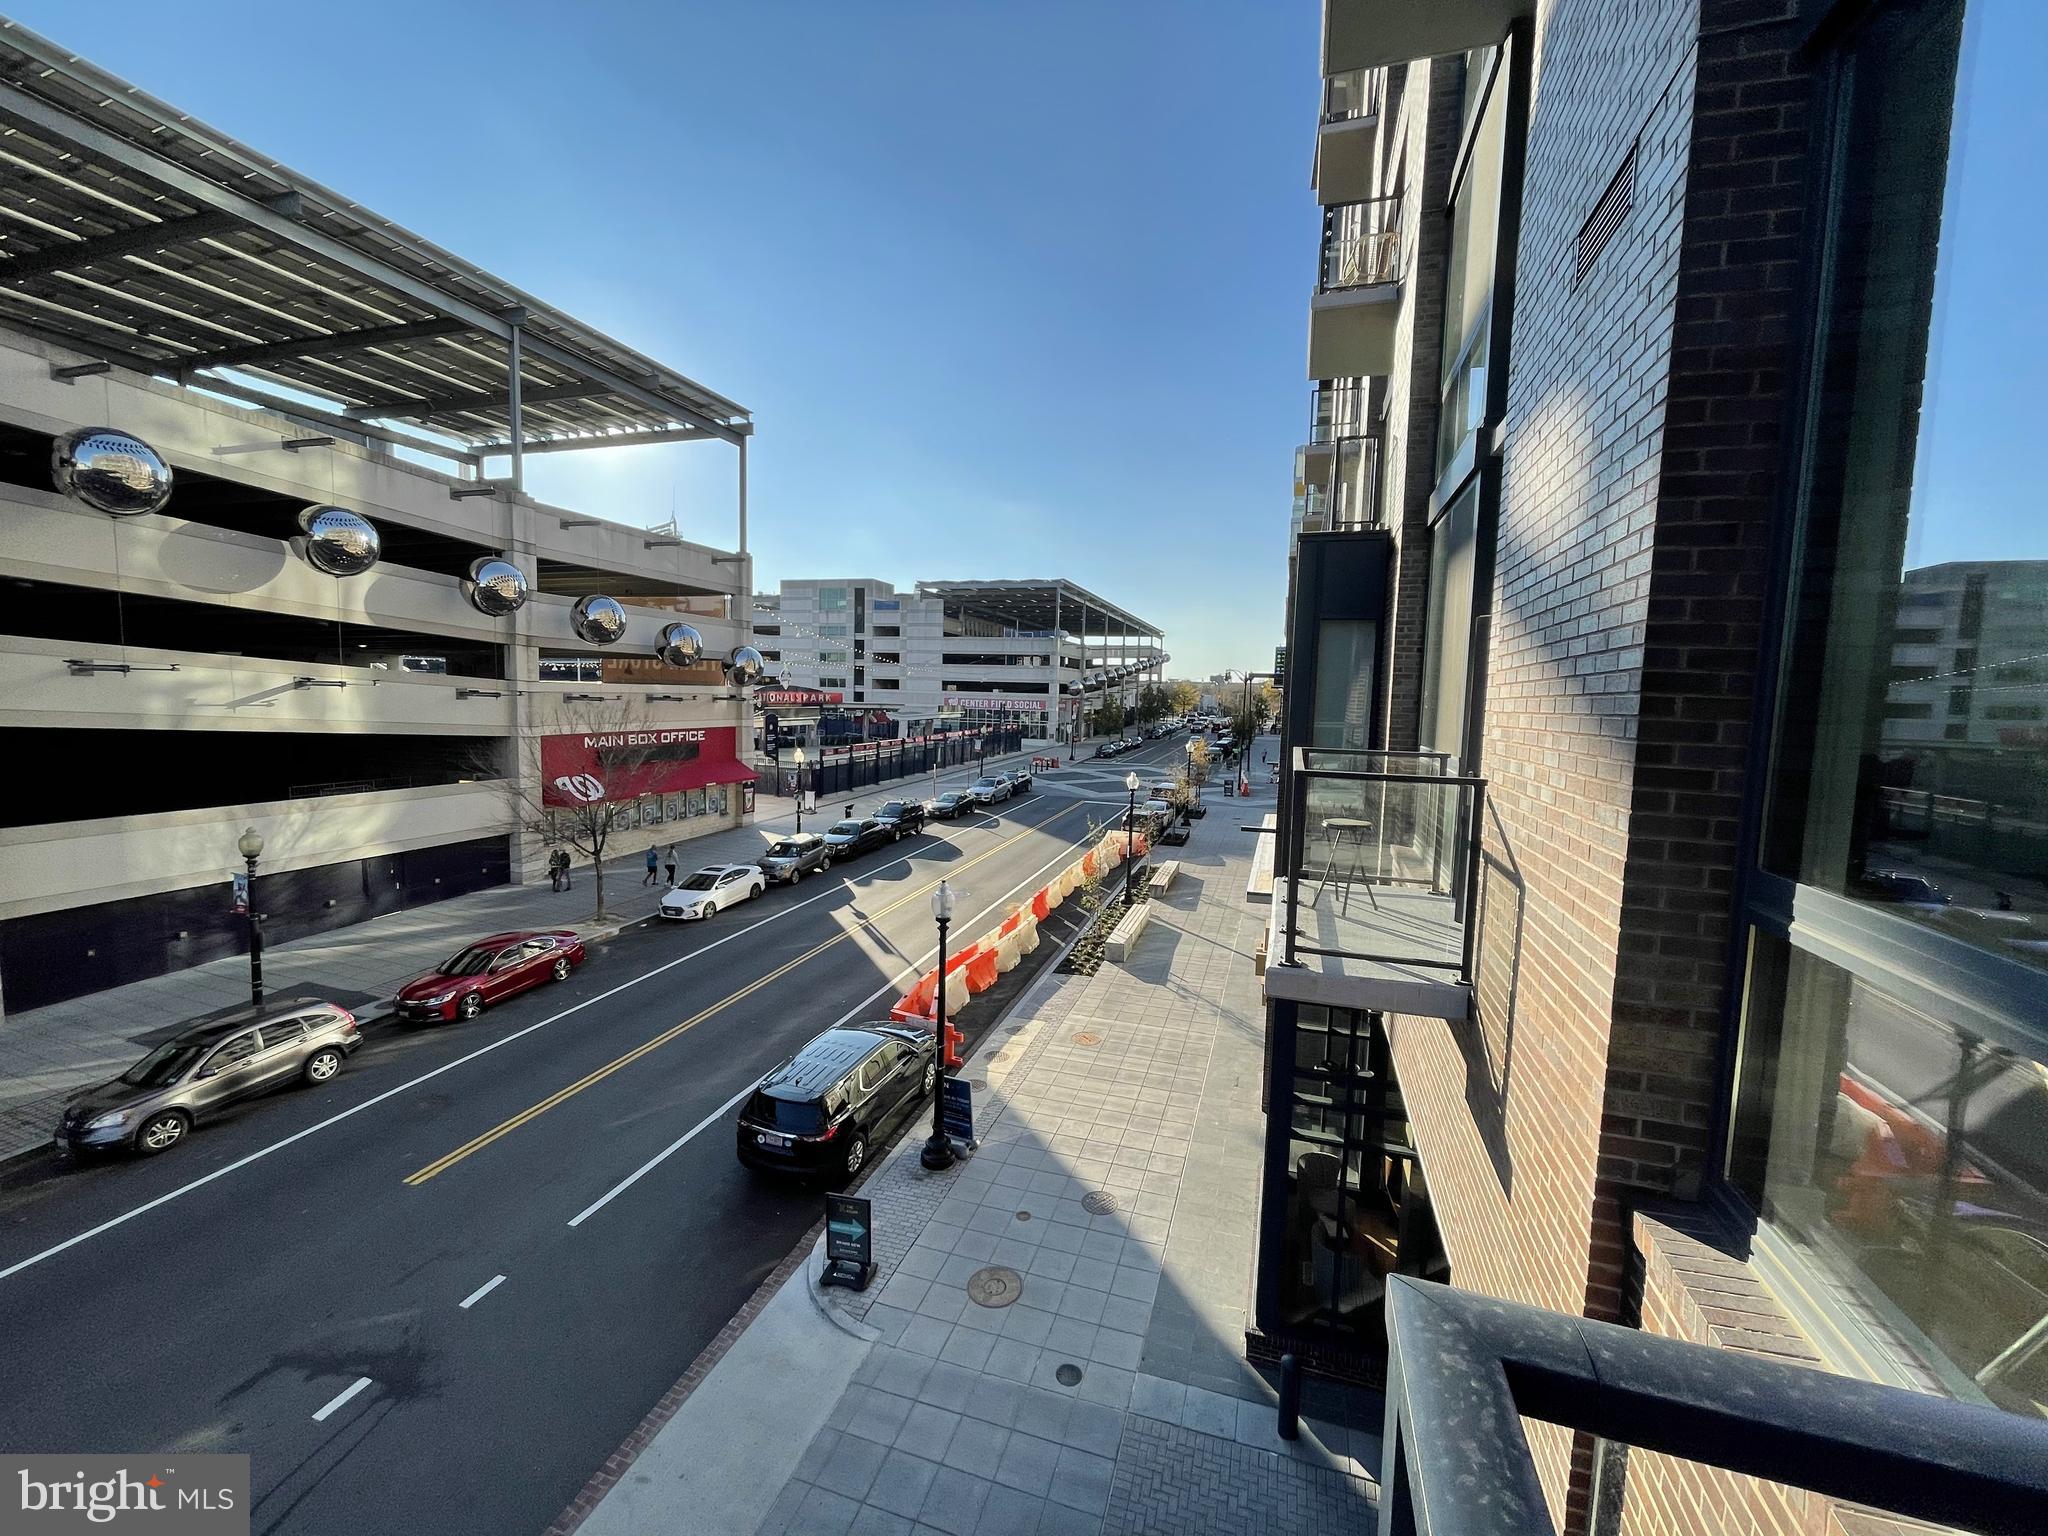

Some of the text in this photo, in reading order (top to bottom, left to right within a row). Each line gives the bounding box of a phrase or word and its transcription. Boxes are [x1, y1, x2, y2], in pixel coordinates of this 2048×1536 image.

[803, 693, 832, 702] PARK
[960, 699, 989, 708] CENTER
[1014, 700, 1042, 709] SOCIAL
[584, 730, 706, 749] MAIN BOX OFFICE
